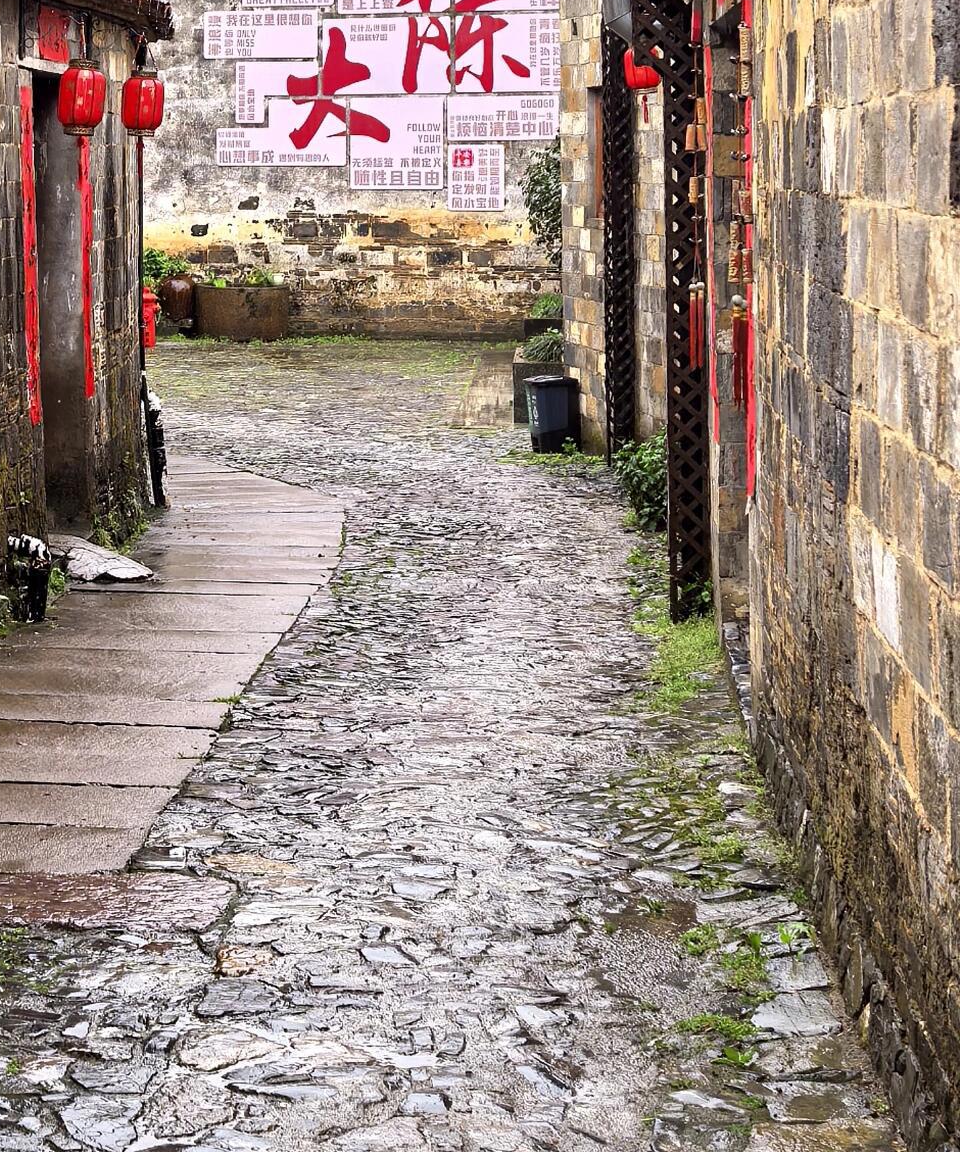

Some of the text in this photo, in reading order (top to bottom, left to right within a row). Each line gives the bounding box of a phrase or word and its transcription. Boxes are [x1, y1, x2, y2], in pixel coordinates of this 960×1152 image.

[226, 13, 313, 27] 我在这里很想你
[236, 39, 255, 47] MISS
[236, 48, 252, 56] YOU
[496, 110, 518, 121] 开心
[406, 123, 441, 132] FOLLOW
[417, 134, 441, 143] YOUR
[412, 145, 441, 154] HEART
[219, 150, 274, 163] 心想事成
[354, 169, 440, 186] 随性且自由
[451, 197, 500, 209] 风水宝地
